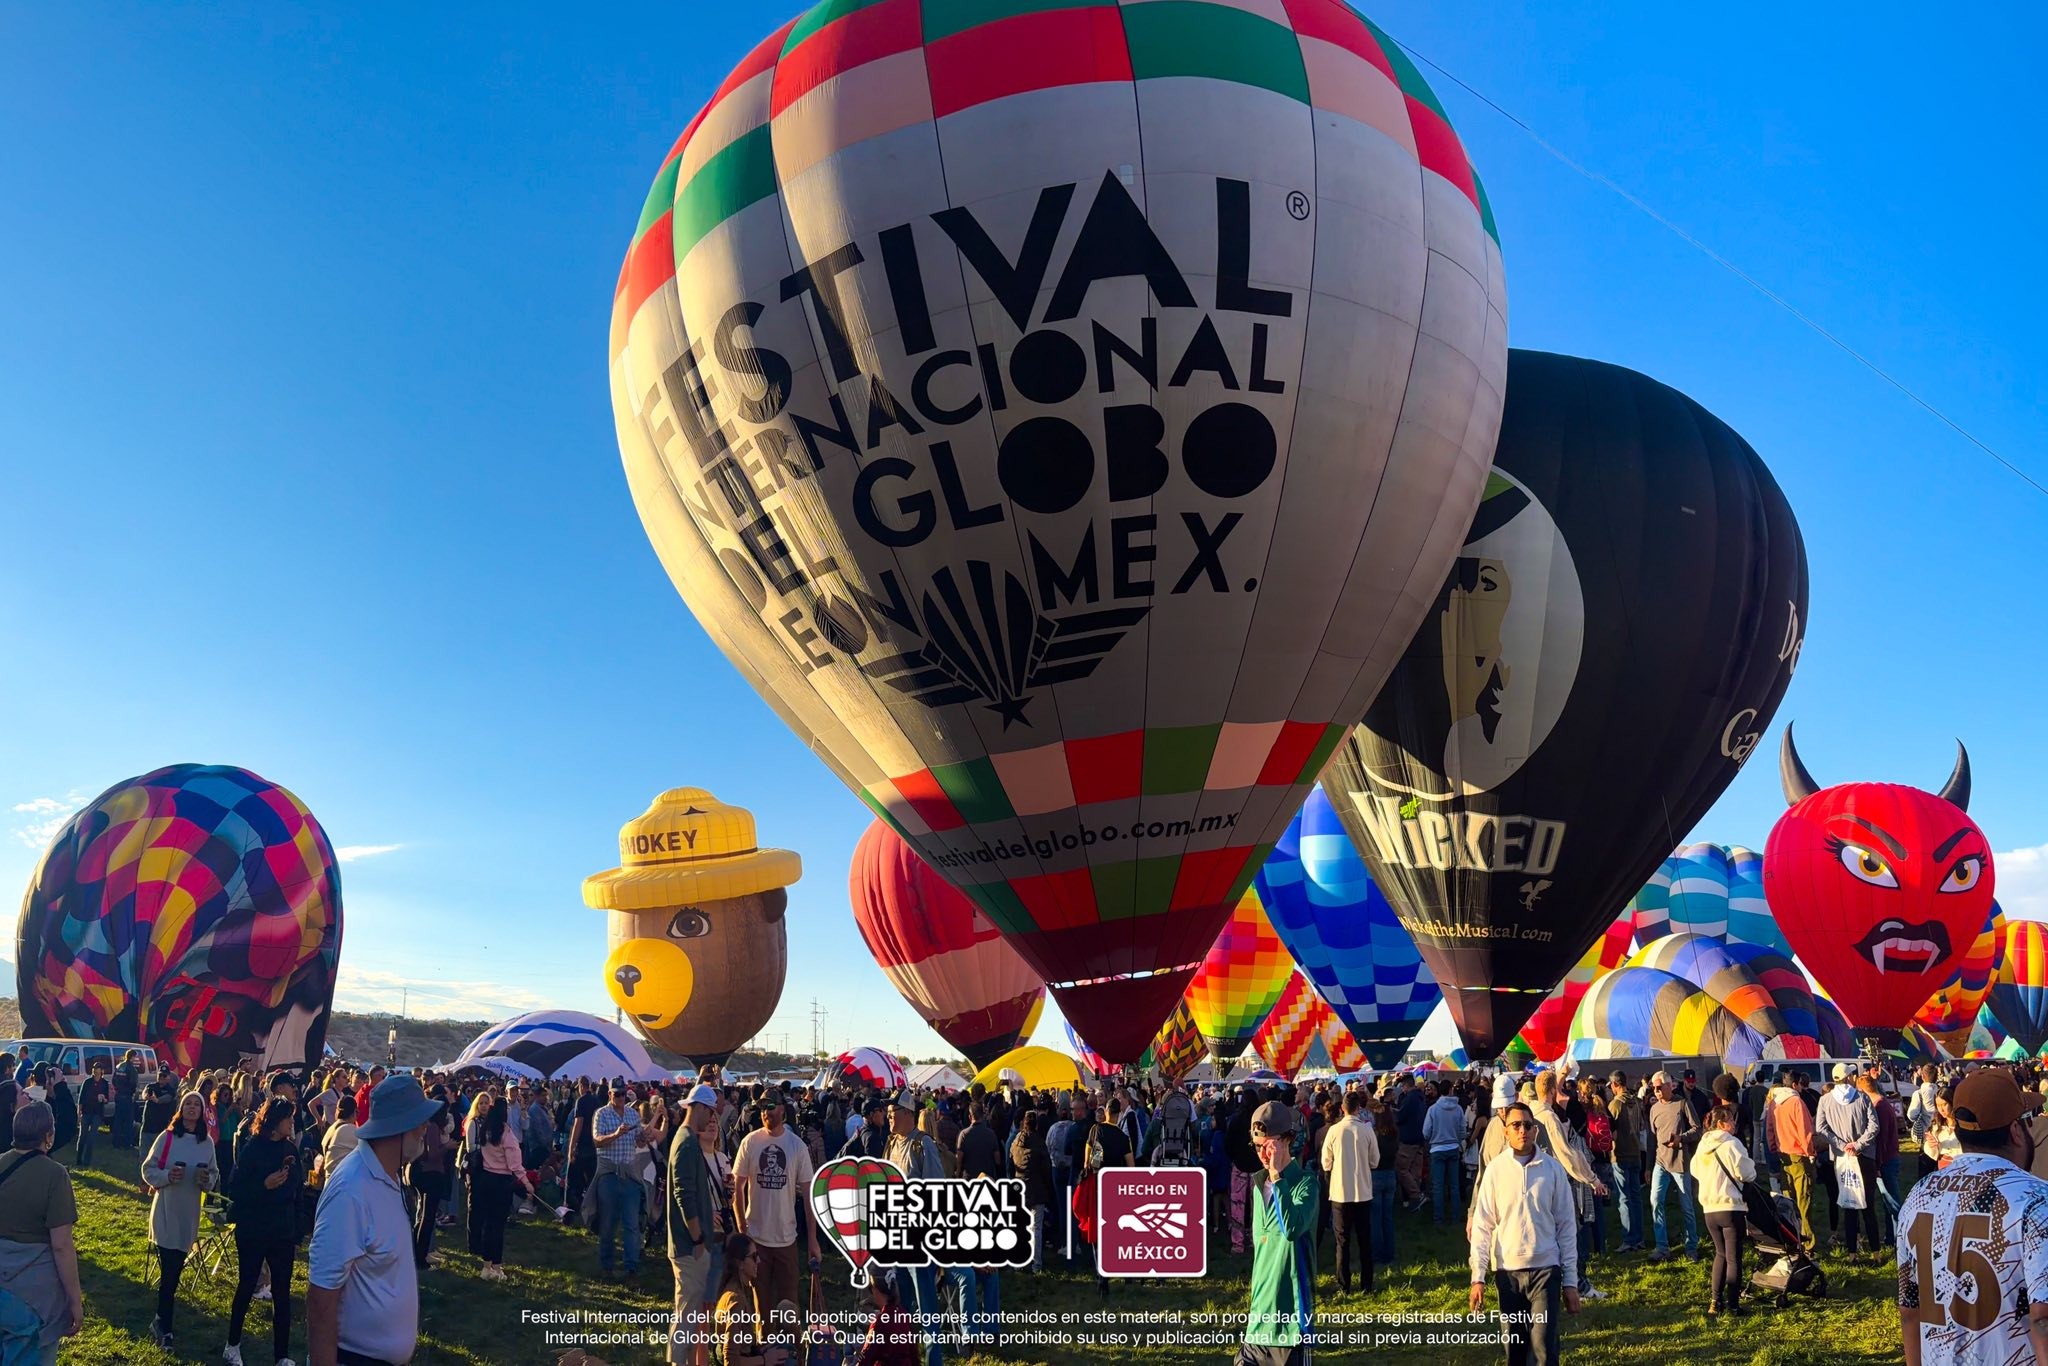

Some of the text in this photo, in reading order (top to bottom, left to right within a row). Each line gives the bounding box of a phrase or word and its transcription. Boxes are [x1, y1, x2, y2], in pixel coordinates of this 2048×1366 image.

[853, 402, 1277, 547] GLOBO
[1926, 1174, 1988, 1192] FOZZY
[1907, 1212, 2001, 1331] 15
